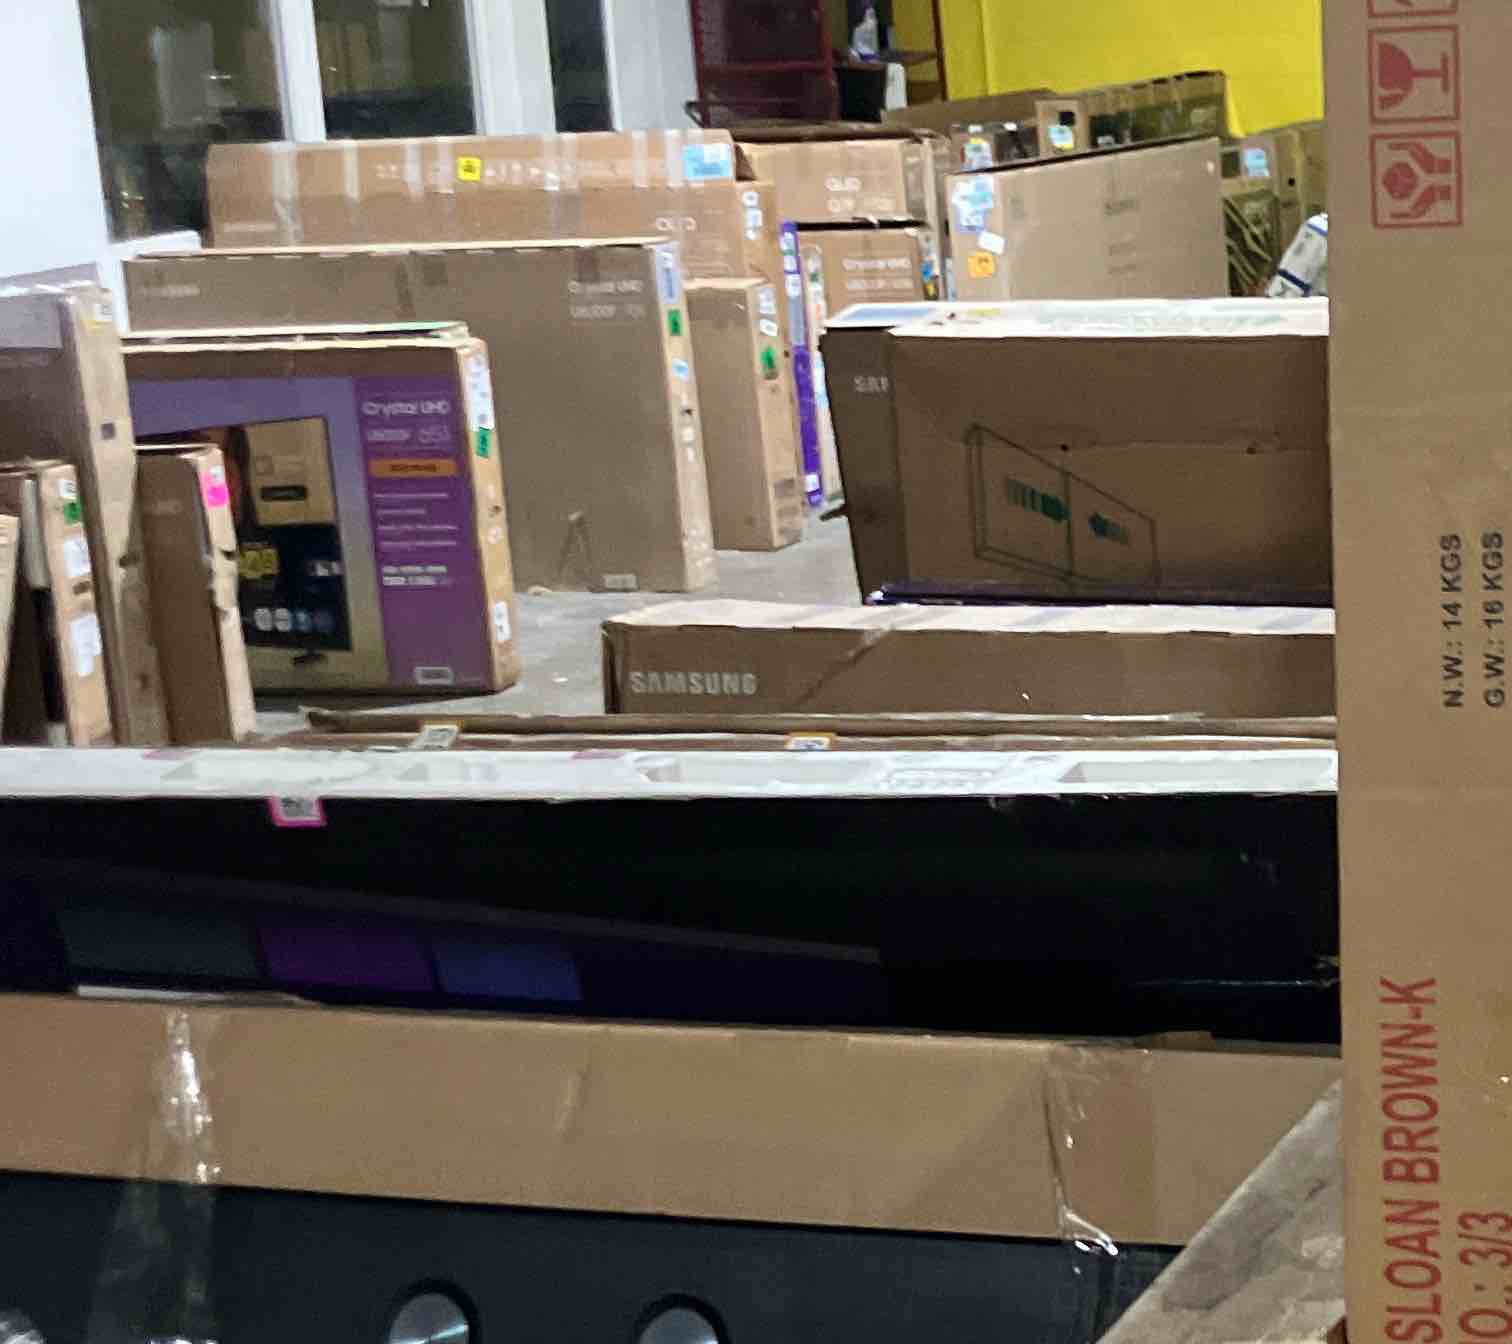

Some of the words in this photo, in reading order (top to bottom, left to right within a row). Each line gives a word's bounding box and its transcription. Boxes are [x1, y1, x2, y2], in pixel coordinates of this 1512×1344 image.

[1439, 533, 1463, 595] KGS
[1481, 530, 1505, 592] KGS
[1441, 599, 1463, 633] 14
[628, 669, 760, 697] SAMSUNG
[1440, 639, 1464, 709] N.W.:
[1482, 639, 1506, 709] G.W.:
[1379, 975, 1441, 1185] BROWN-K
